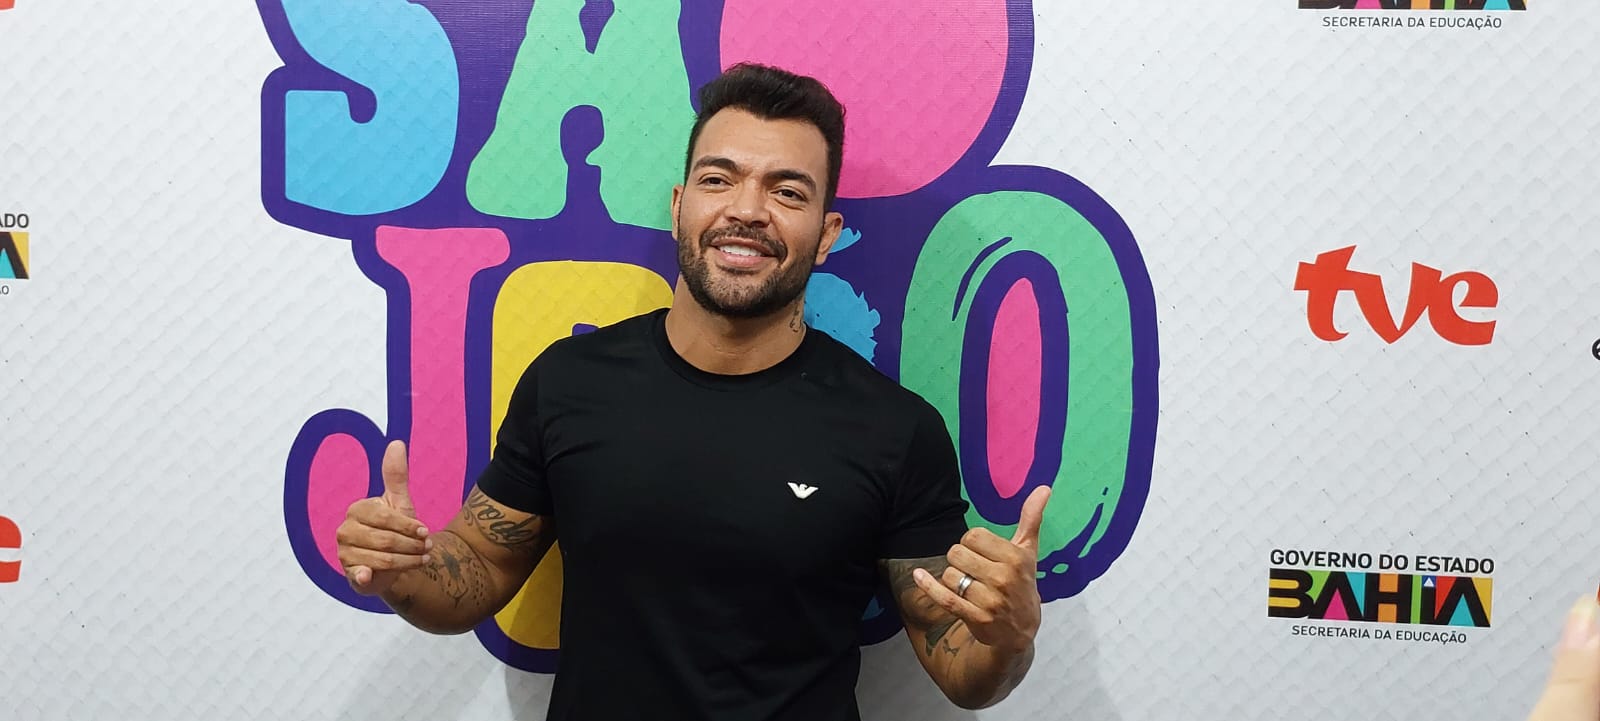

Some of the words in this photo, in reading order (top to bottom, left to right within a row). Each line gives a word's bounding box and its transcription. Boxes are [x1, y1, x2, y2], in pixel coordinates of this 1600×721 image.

[1322, 16, 1403, 27] SECRETARIA
[1407, 17, 1425, 28] DA
[1430, 15, 1502, 30] EDUCAÇÃO
[1294, 245, 1499, 346] tve
[1270, 549, 1373, 569] GOVERNO
[1379, 554, 1409, 571] DO
[1415, 556, 1495, 574] ESTADO
[1292, 625, 1371, 640] SECRETARIA
[1374, 629, 1392, 641] DA
[1396, 629, 1467, 645] EDUCAÇÃO
